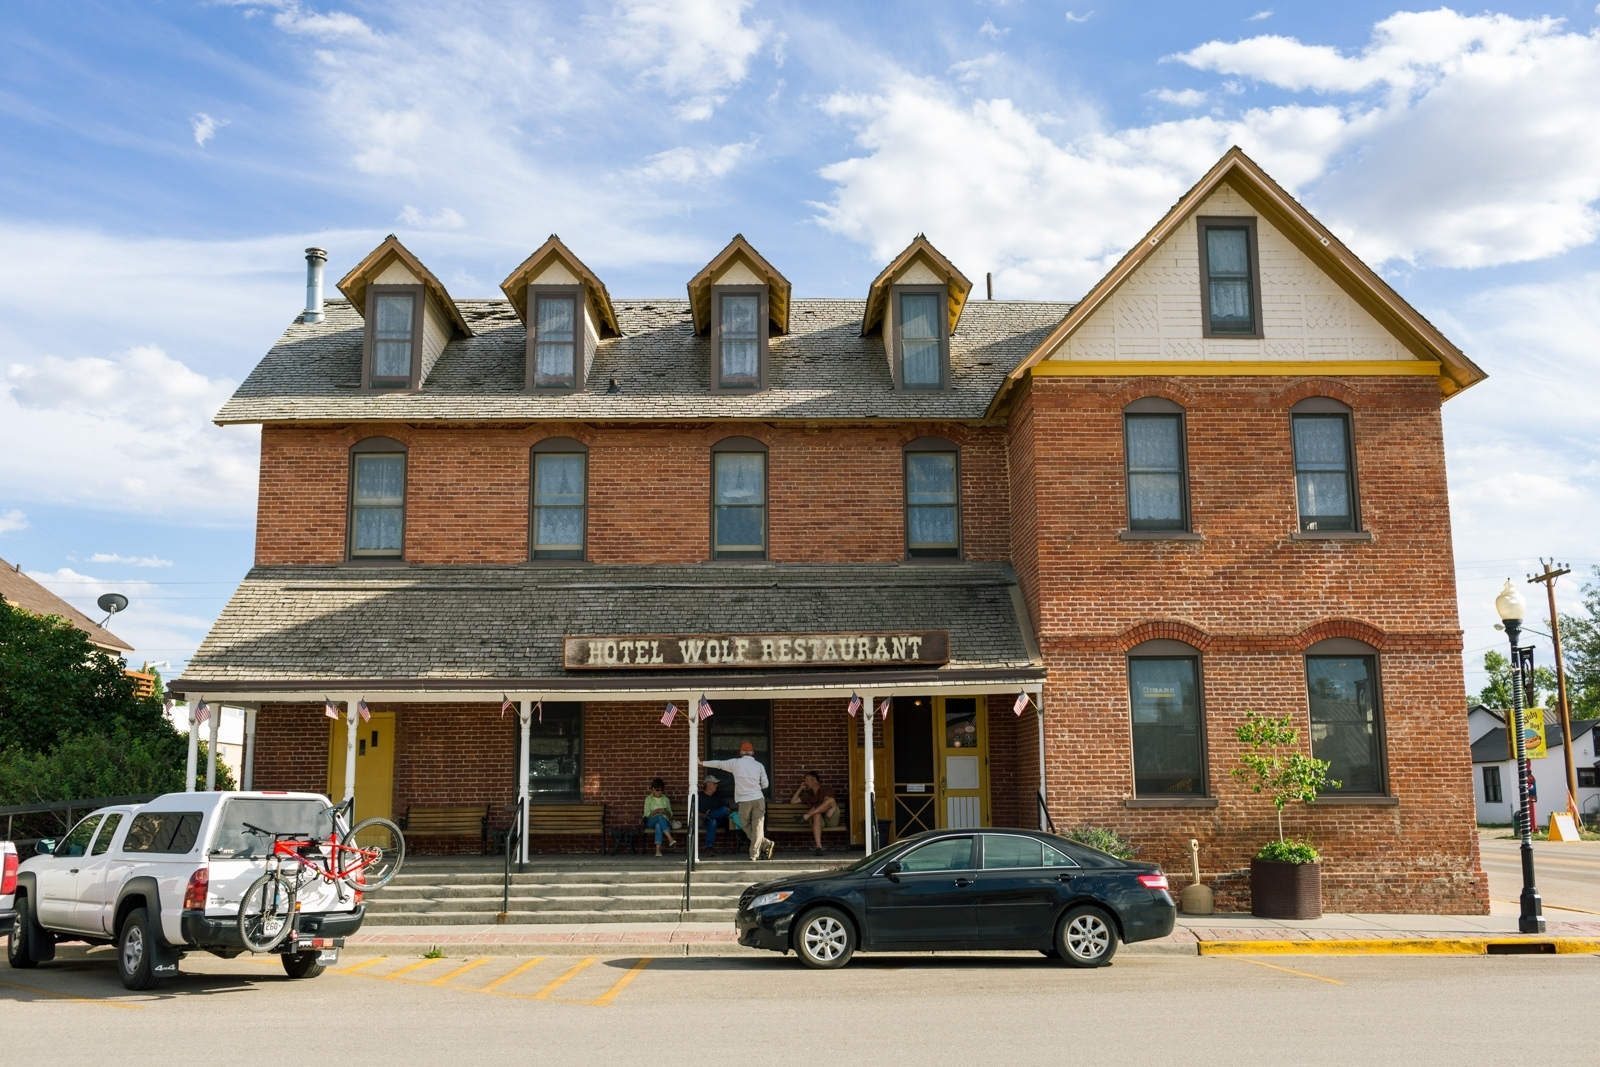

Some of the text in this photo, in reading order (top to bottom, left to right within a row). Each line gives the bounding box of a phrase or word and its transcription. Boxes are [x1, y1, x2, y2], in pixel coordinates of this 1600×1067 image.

[588, 636, 922, 665] HOTEL WOLF RESTAURANT
